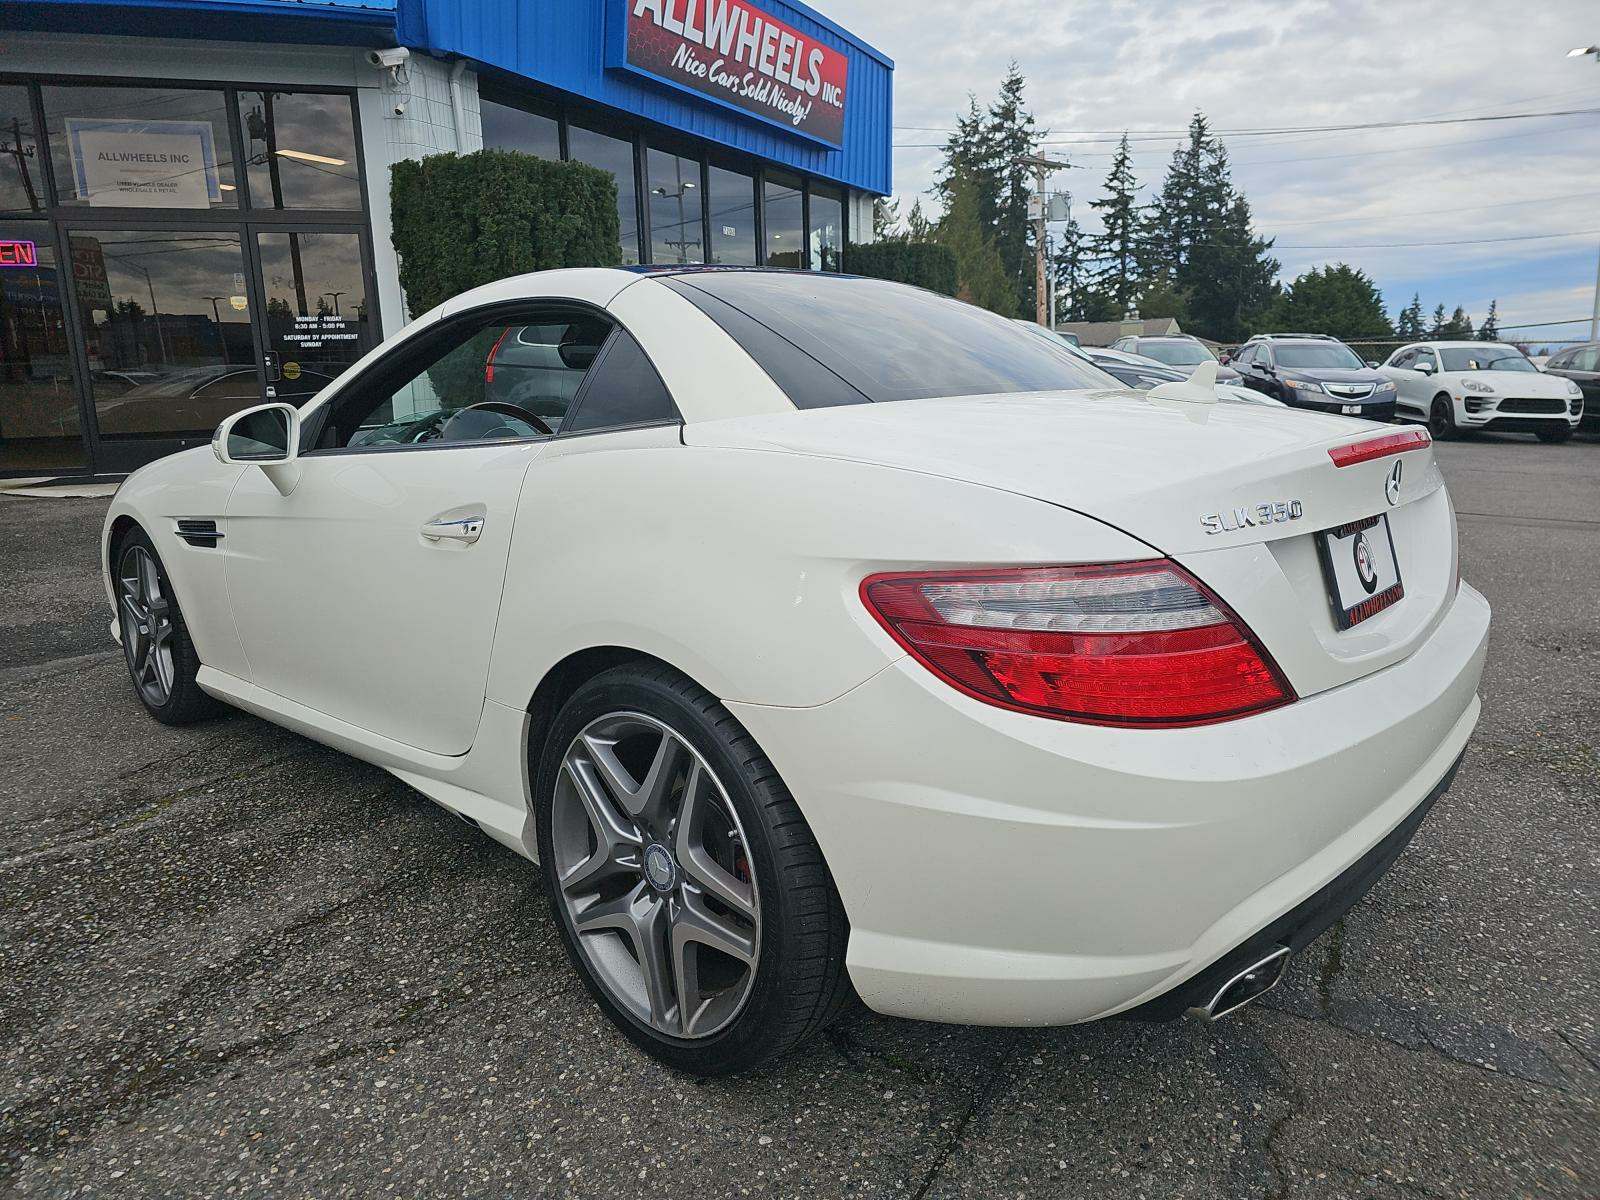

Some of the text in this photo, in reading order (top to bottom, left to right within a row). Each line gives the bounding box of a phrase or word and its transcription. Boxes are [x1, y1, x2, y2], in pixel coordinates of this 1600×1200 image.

[671, 43, 812, 125] Nice Cars Sold Nicely!
[822, 82, 843, 108] INC.
[98, 151, 190, 163] ALLWHEELS INC
[1200, 499, 1303, 536] SLK 350
